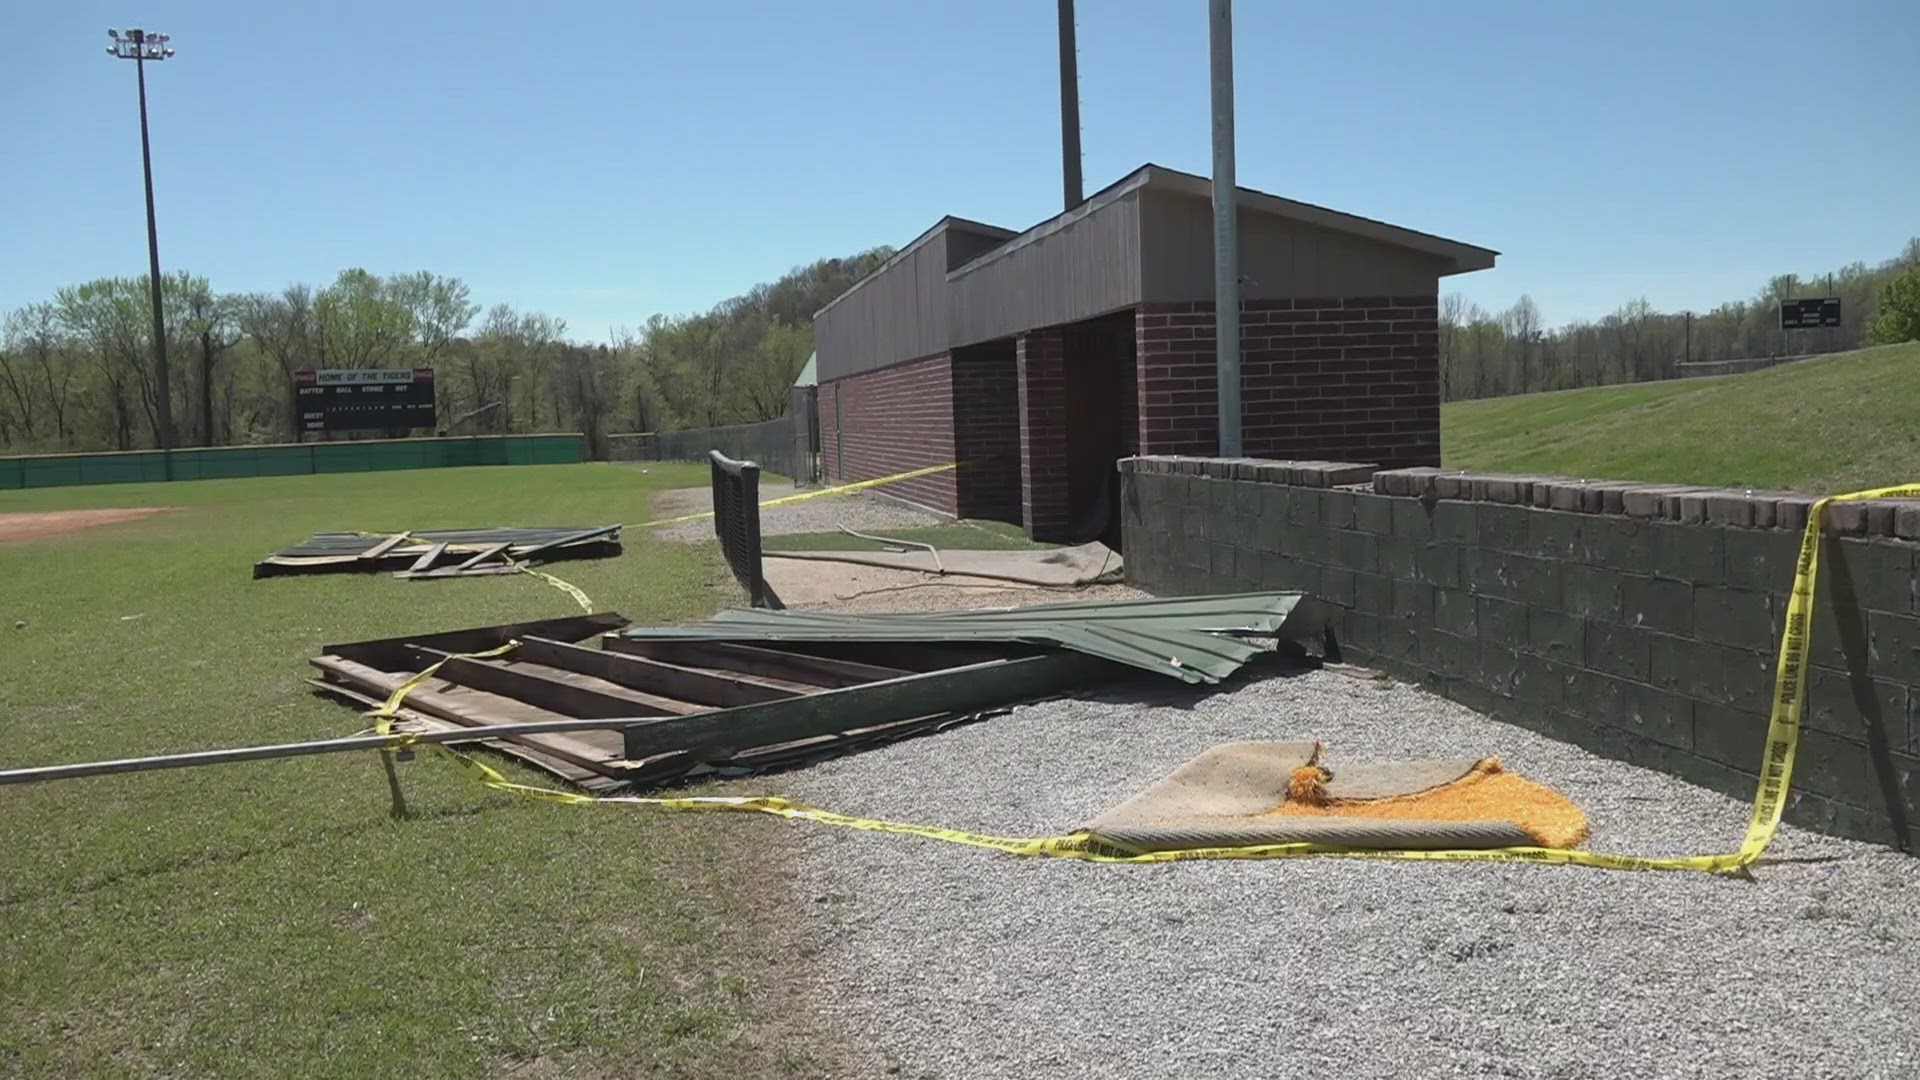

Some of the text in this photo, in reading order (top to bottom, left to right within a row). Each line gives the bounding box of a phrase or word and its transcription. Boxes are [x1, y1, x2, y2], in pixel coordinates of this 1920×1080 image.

[318, 373, 342, 382] HOME
[347, 372, 358, 381] OF
[362, 372, 377, 380] THE
[383, 371, 411, 380] TIGERS
[336, 386, 352, 394] BALL
[395, 384, 408, 392] OUT
[1788, 613, 1804, 635] CROSS
[1787, 637, 1802, 651] NOT
[1784, 663, 1800, 679] LINE
[1780, 680, 1797, 705] POLICE
[1768, 764, 1783, 778] NOT
[1762, 789, 1779, 804] LINE
[1758, 804, 1775, 826] POLICE
[1055, 839, 1075, 851] POLICE
